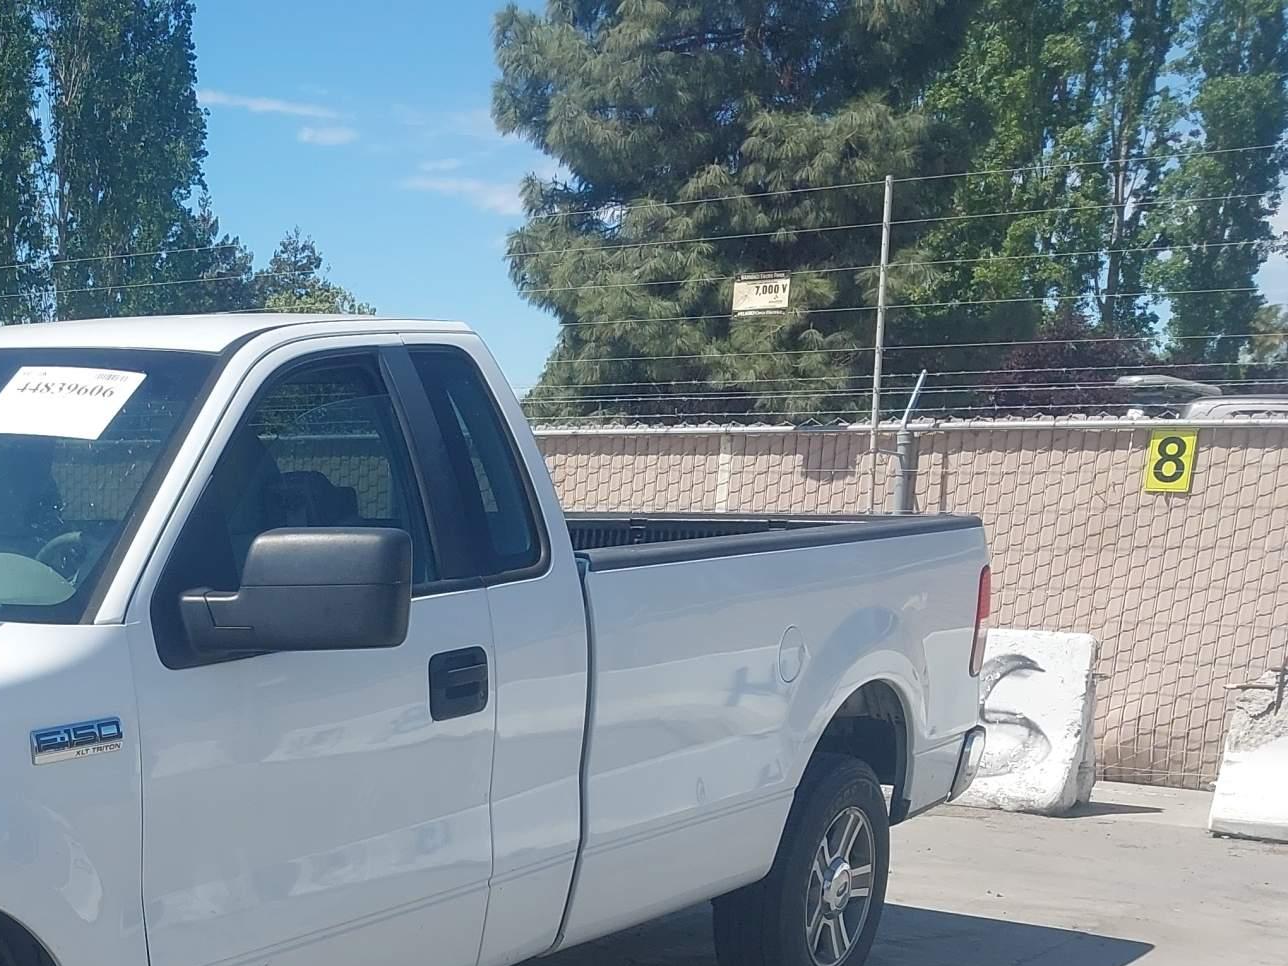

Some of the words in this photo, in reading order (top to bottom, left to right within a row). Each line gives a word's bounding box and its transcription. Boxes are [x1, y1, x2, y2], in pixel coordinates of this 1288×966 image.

[755, 284, 779, 296] 7,000
[782, 284, 788, 293] V
[16, 382, 115, 398] 44839606
[1153, 436, 1187, 483] 8
[75, 748, 91, 757] XLT
[92, 743, 121, 753] TRITON
